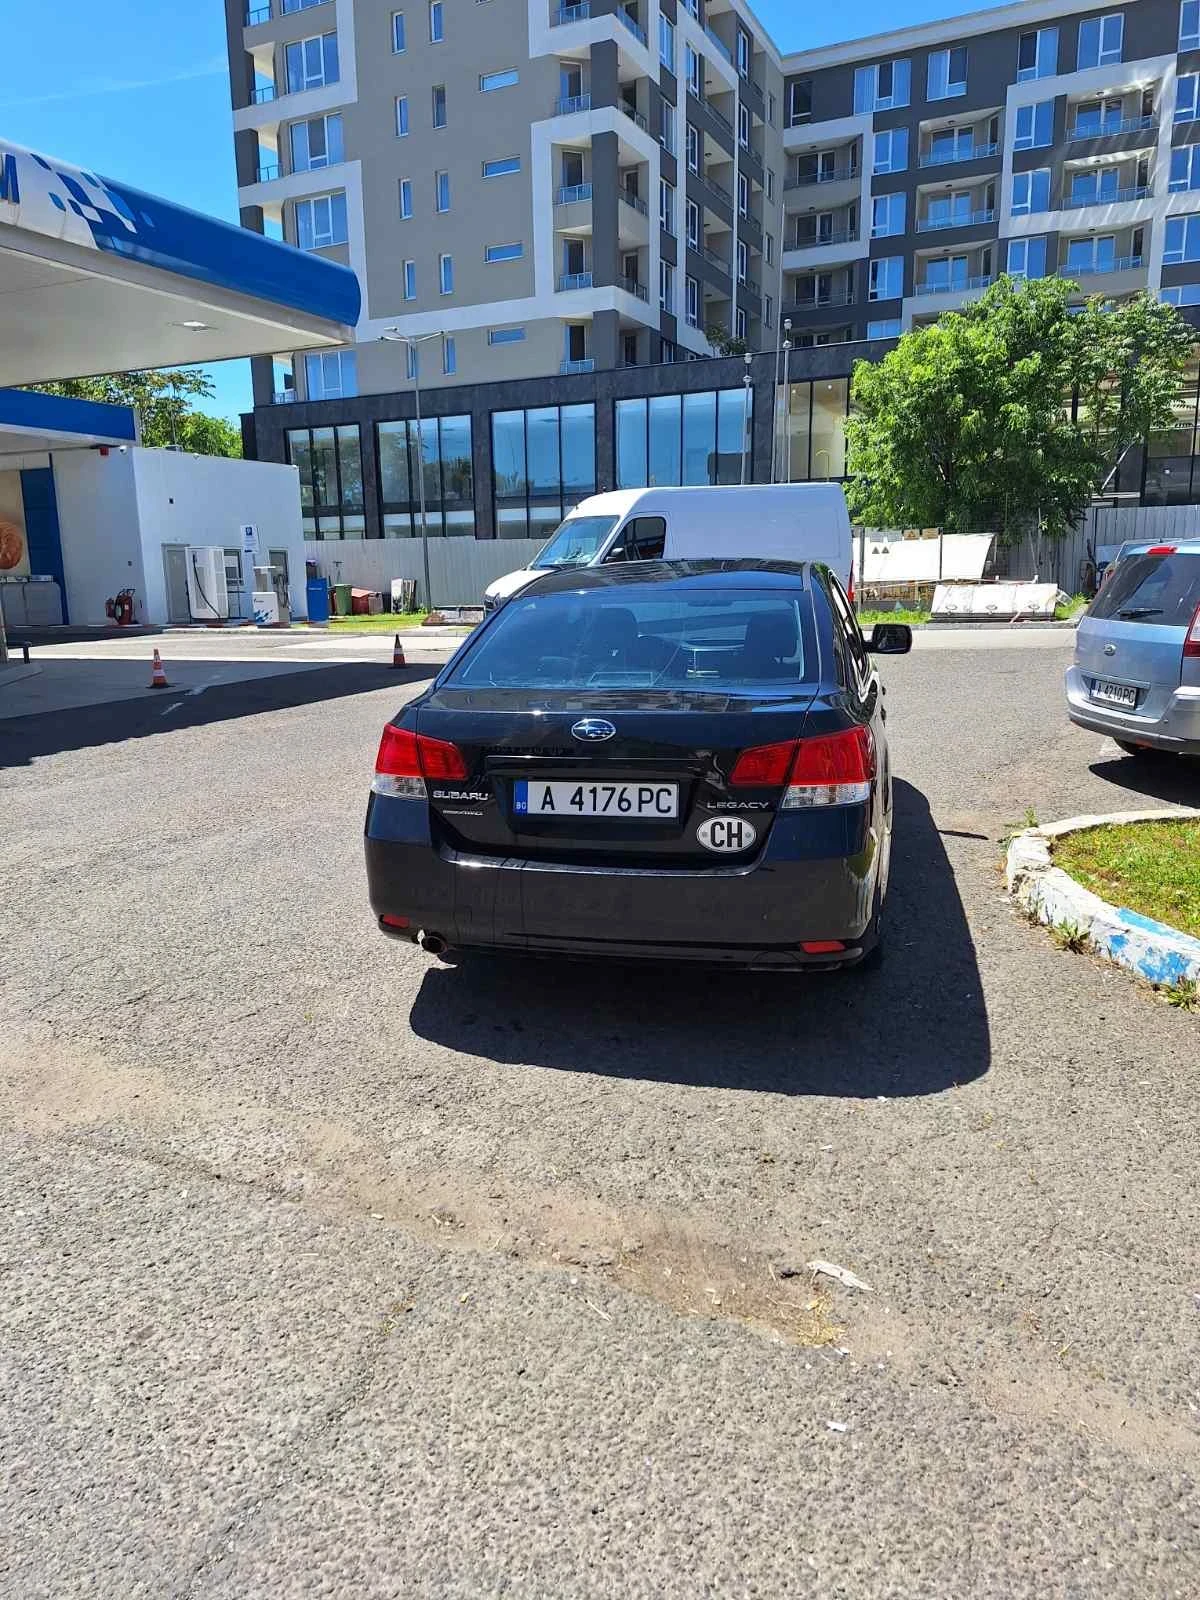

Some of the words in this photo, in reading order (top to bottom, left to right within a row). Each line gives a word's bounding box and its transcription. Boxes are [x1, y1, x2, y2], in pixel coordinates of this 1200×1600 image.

[433, 790, 488, 801] SUBARU
[540, 785, 555, 811] A
[569, 786, 632, 813] 4176
[638, 788, 672, 813] PC
[706, 801, 769, 809] LEGACY
[710, 821, 743, 848] CH
